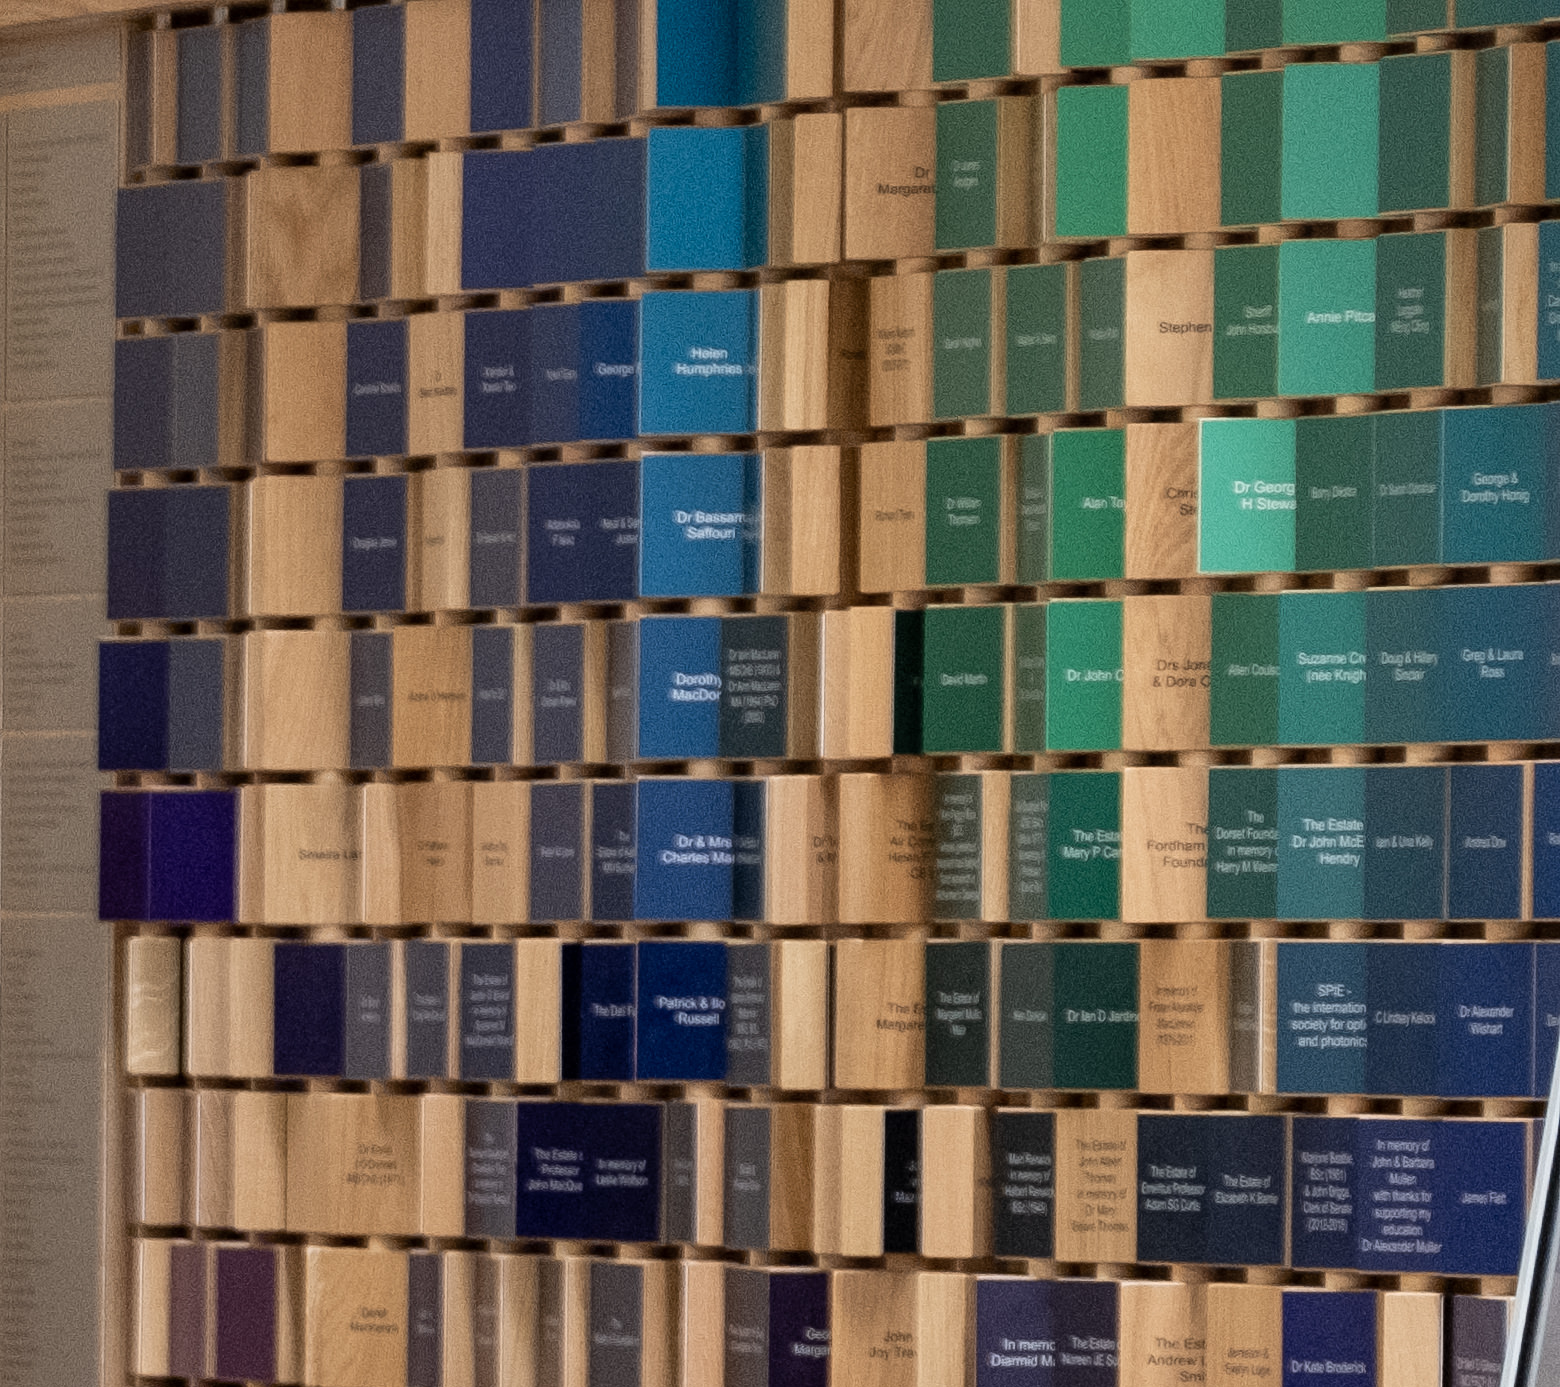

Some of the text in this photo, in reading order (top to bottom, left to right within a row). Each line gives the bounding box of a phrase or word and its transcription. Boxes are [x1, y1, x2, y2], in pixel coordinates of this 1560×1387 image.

[1158, 321, 1214, 335] Stephen
[1233, 481, 1251, 494] Dr
[1303, 818, 1365, 832] The Estate
[1291, 834, 1307, 849] Dr
[1291, 1018, 1329, 1032] society
[1330, 1018, 1344, 1031] for
[1298, 1035, 1318, 1048] and
